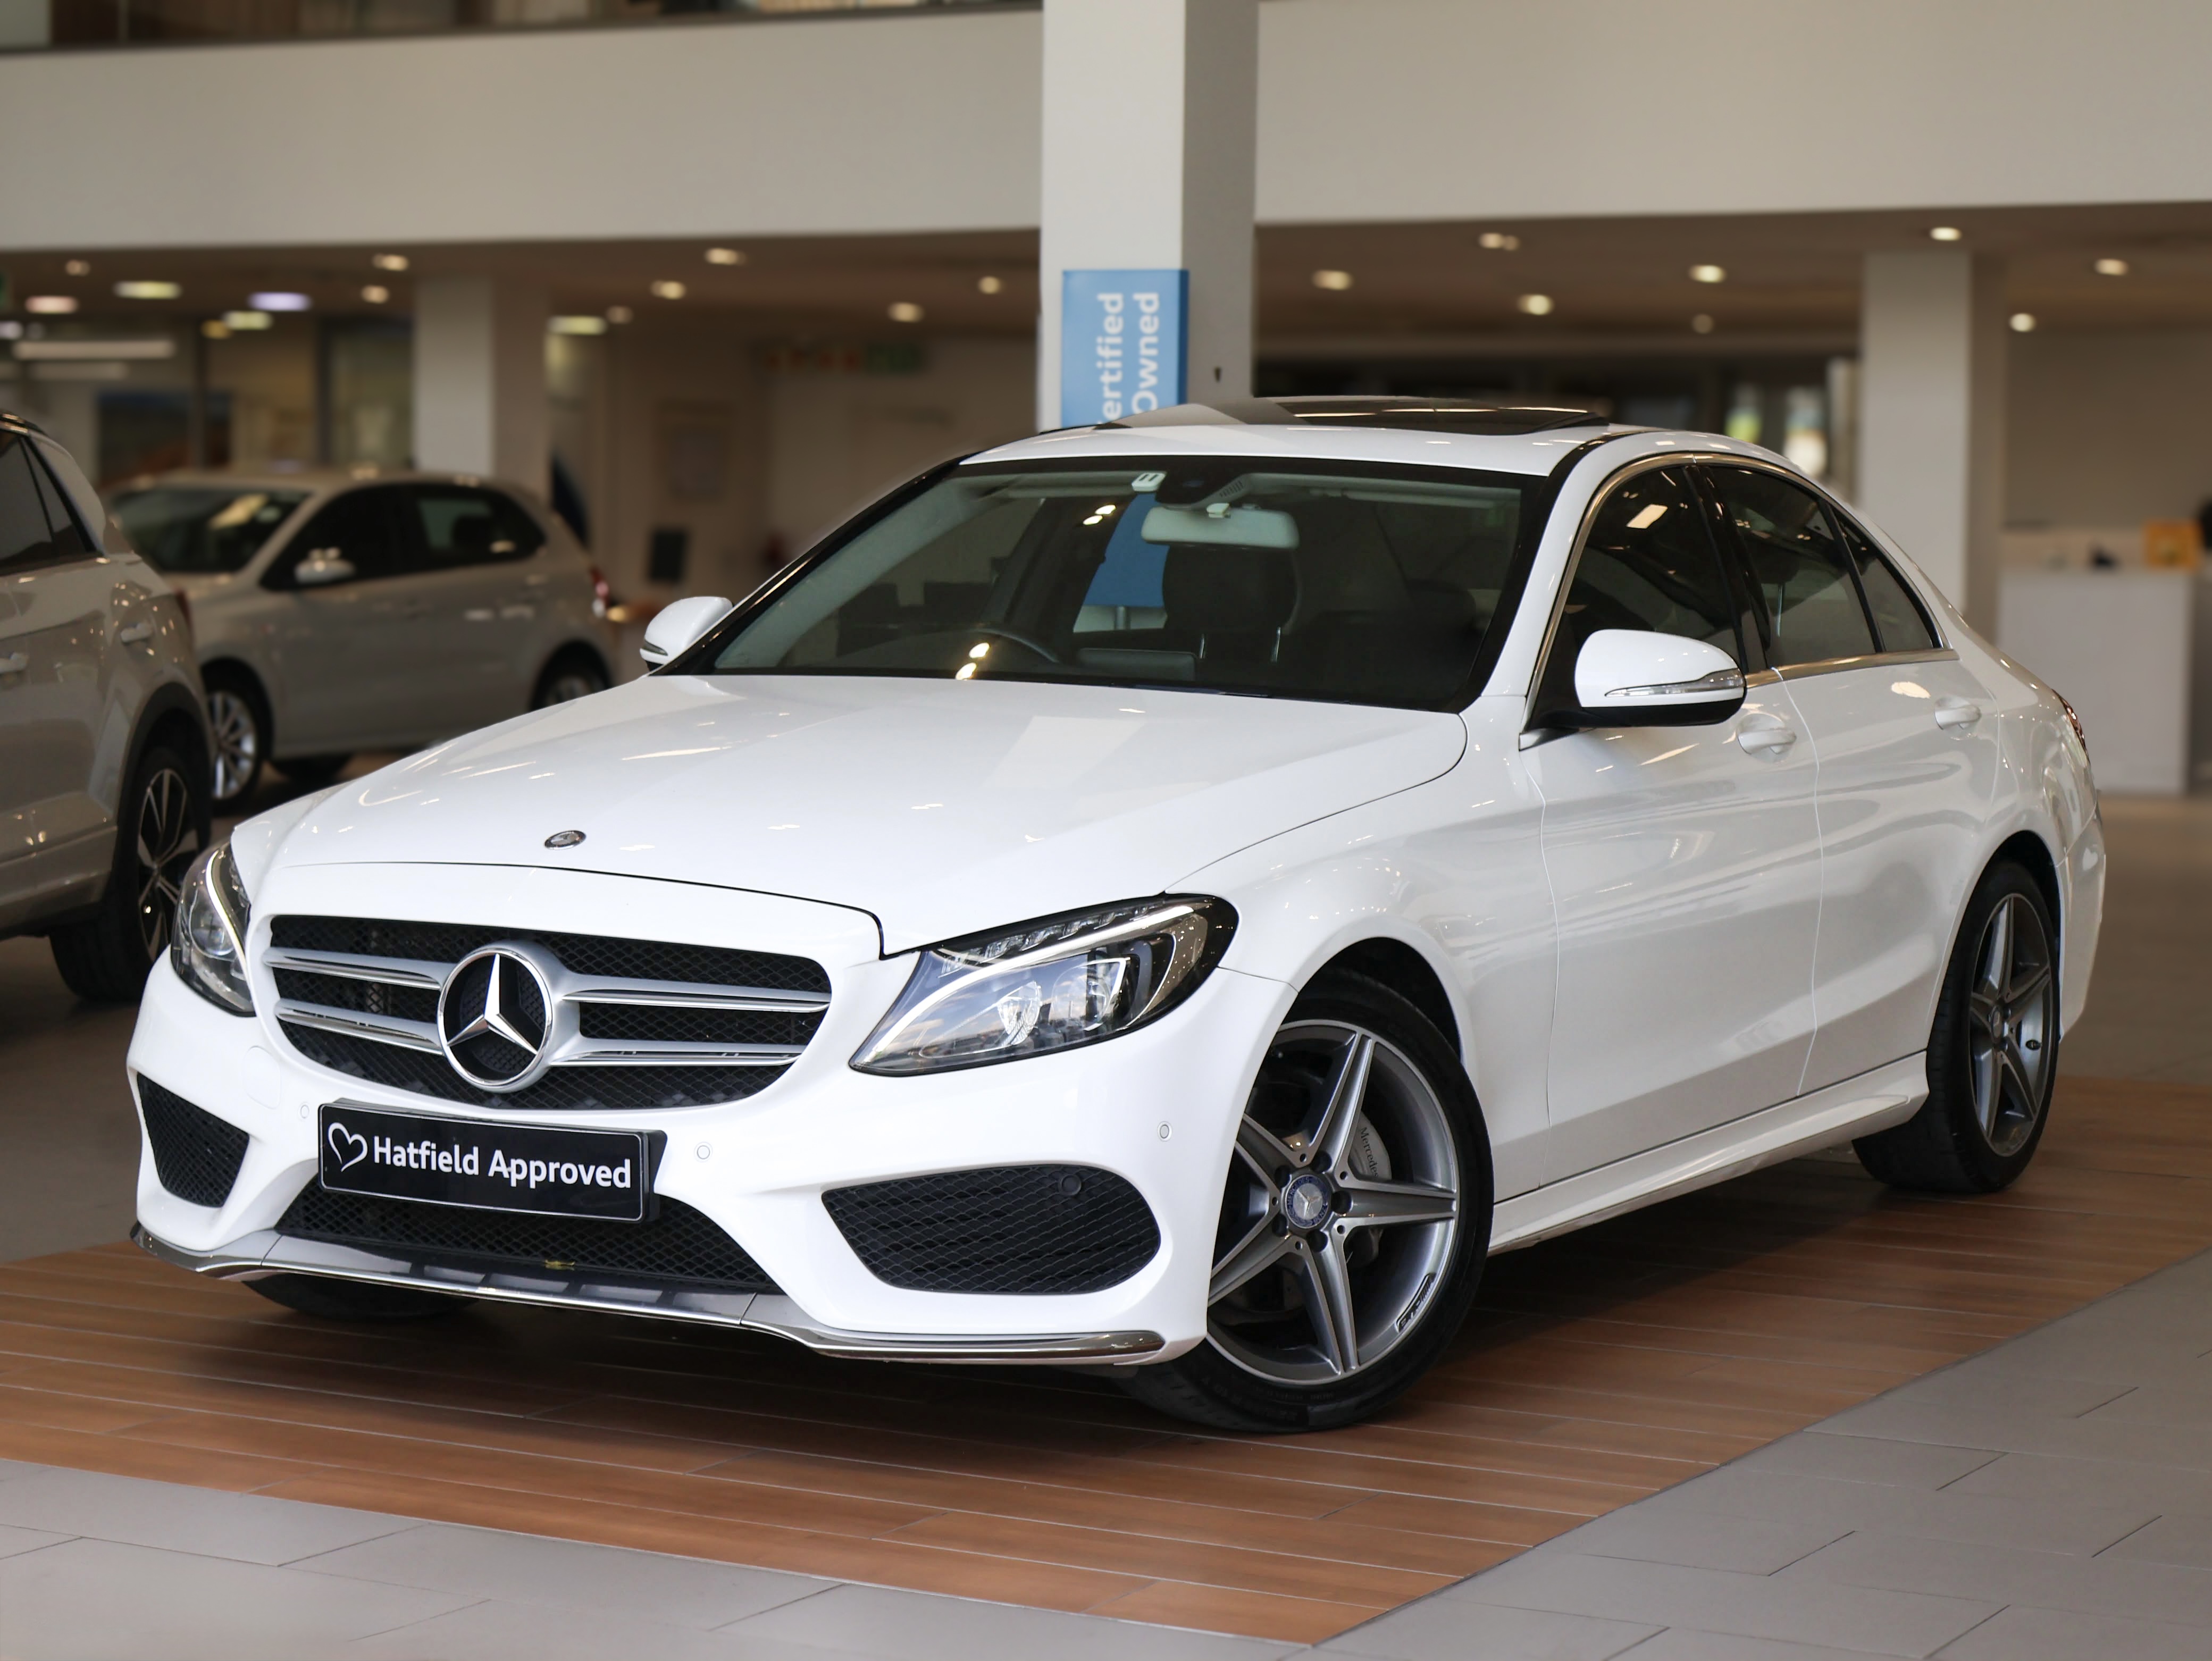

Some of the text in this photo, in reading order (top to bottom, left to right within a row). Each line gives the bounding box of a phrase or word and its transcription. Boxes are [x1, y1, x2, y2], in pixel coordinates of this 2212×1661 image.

[1096, 293, 1123, 425] ertified
[1132, 292, 1159, 414] Owned
[374, 1136, 631, 1189] Hatfield Approved
[1361, 1127, 1379, 1178] Mercedes
